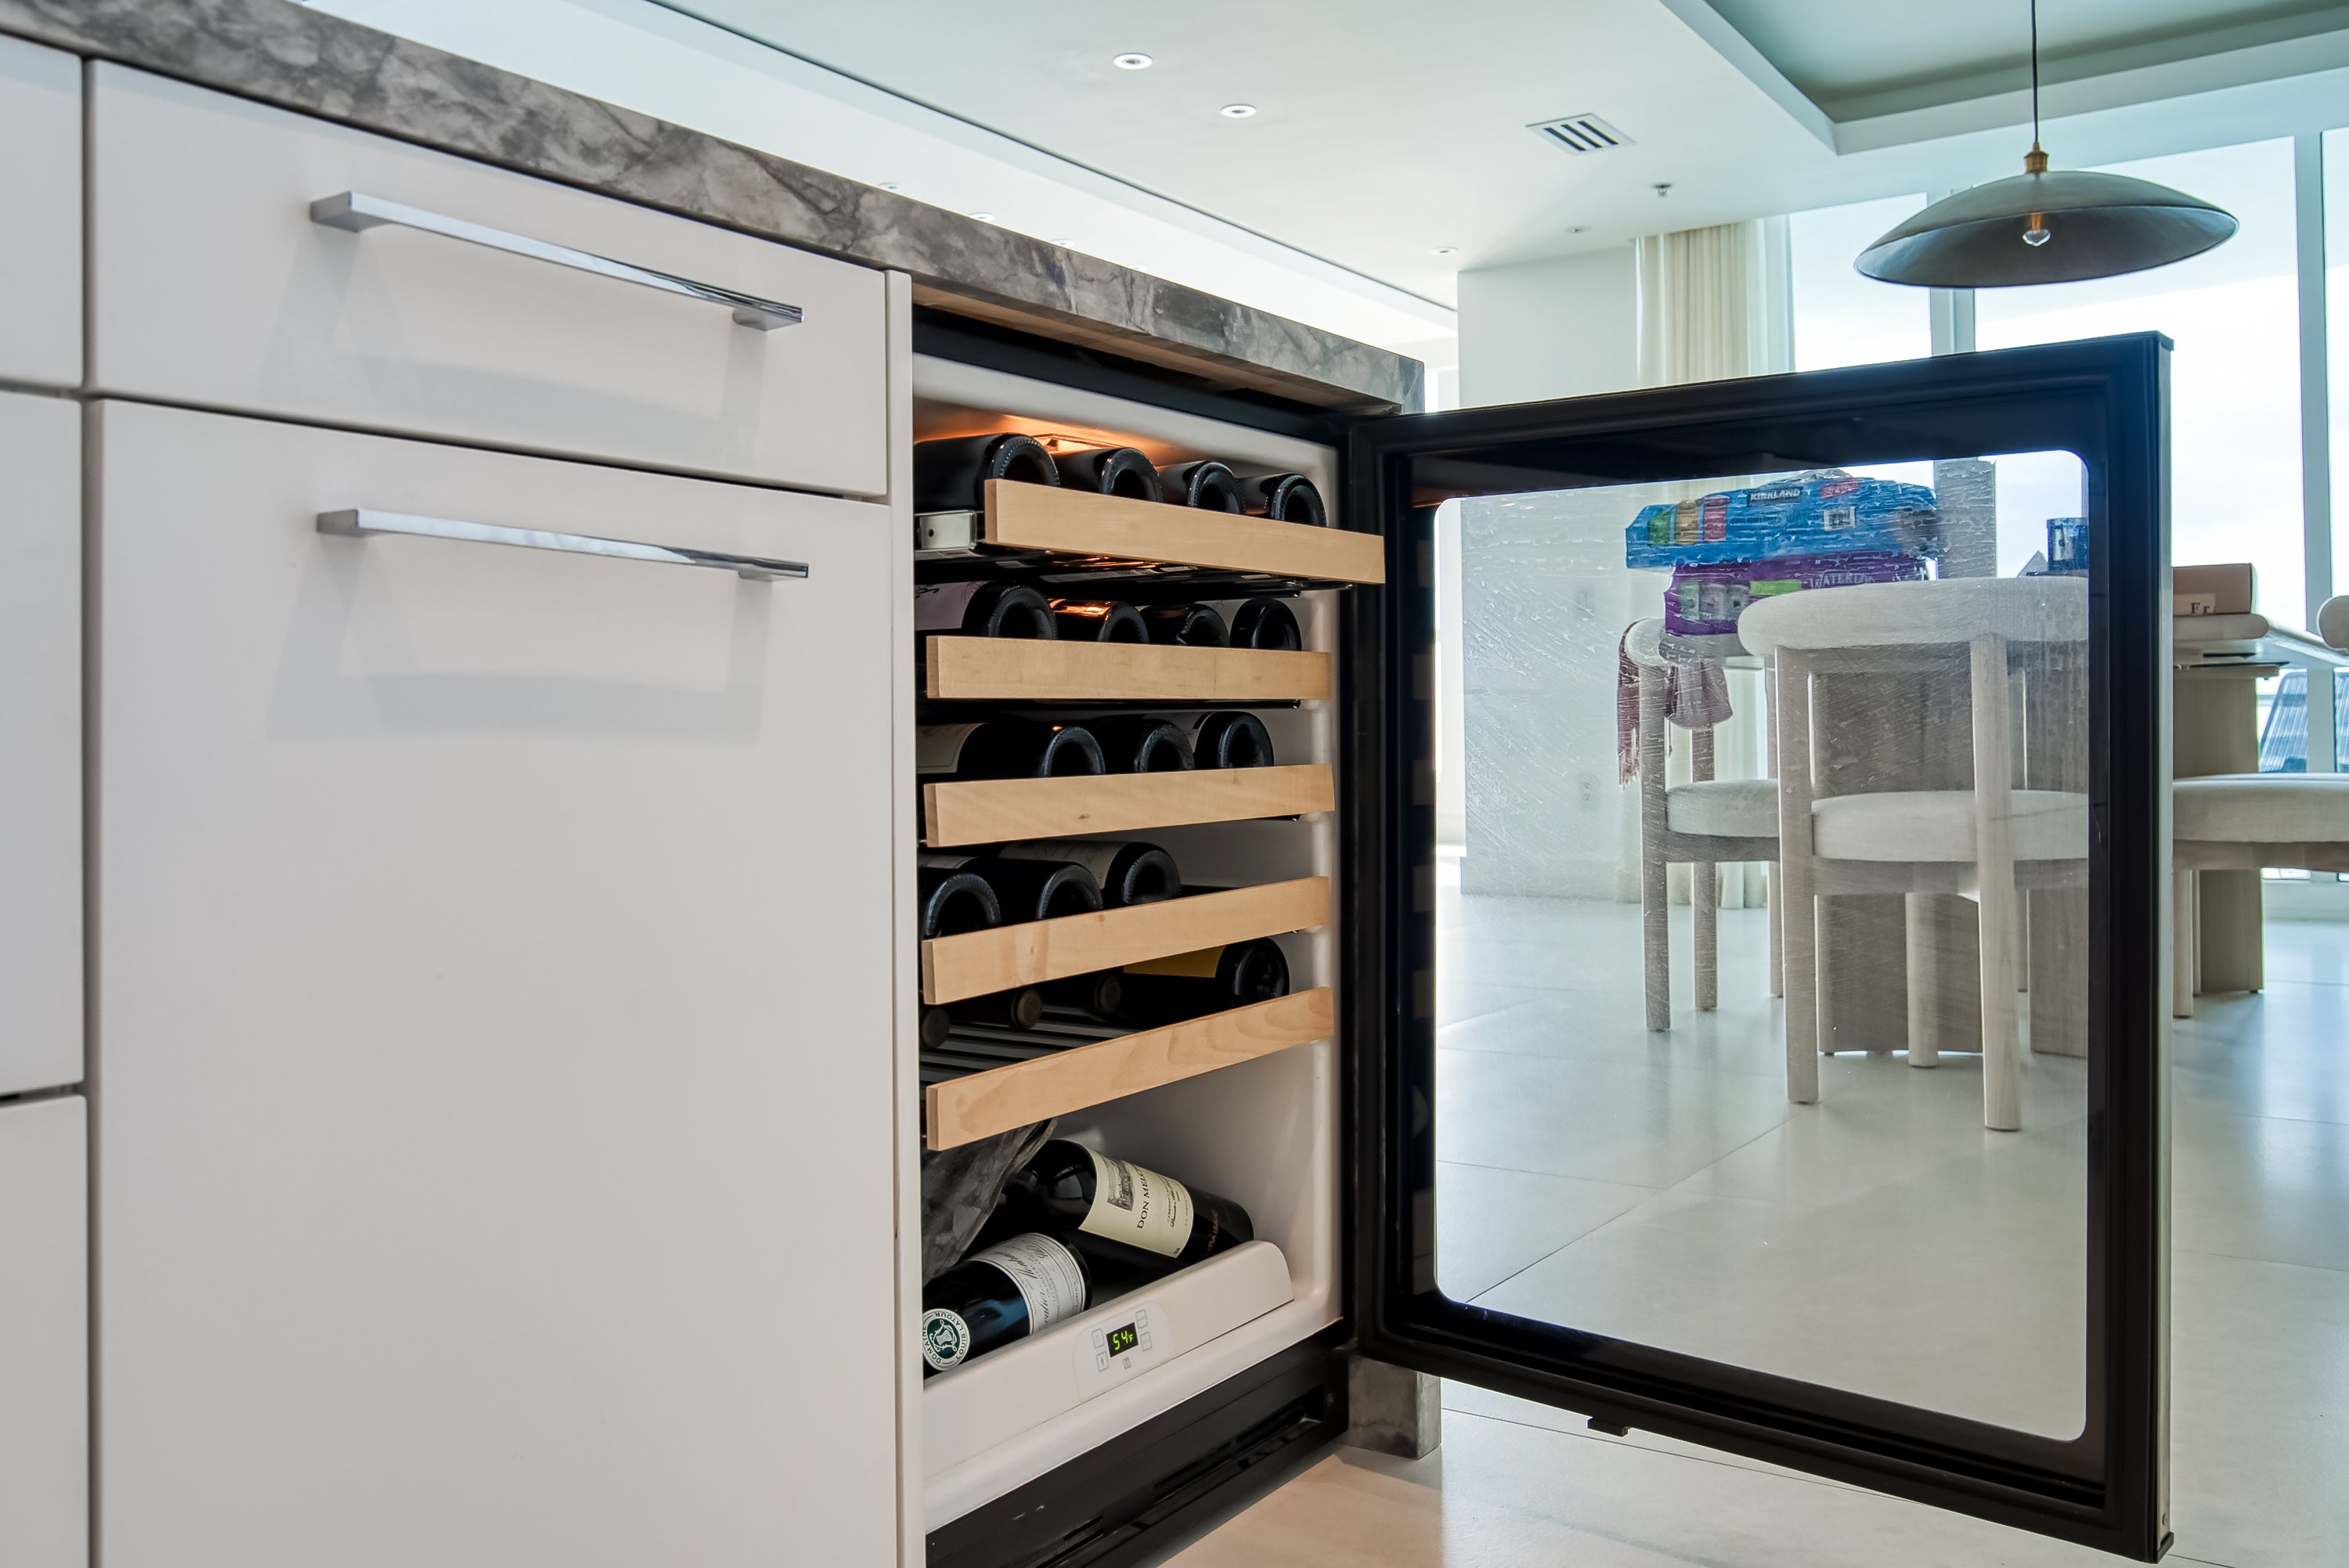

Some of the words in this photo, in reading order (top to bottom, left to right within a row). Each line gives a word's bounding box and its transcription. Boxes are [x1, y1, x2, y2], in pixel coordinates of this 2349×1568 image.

[1750, 489, 1801, 501] KIRKLAND
[1136, 1201, 1149, 1229] DON
[935, 1312, 965, 1332] LATOUR
[922, 1326, 942, 1364] DOMAINE
[955, 1333, 966, 1360] LOUIS
